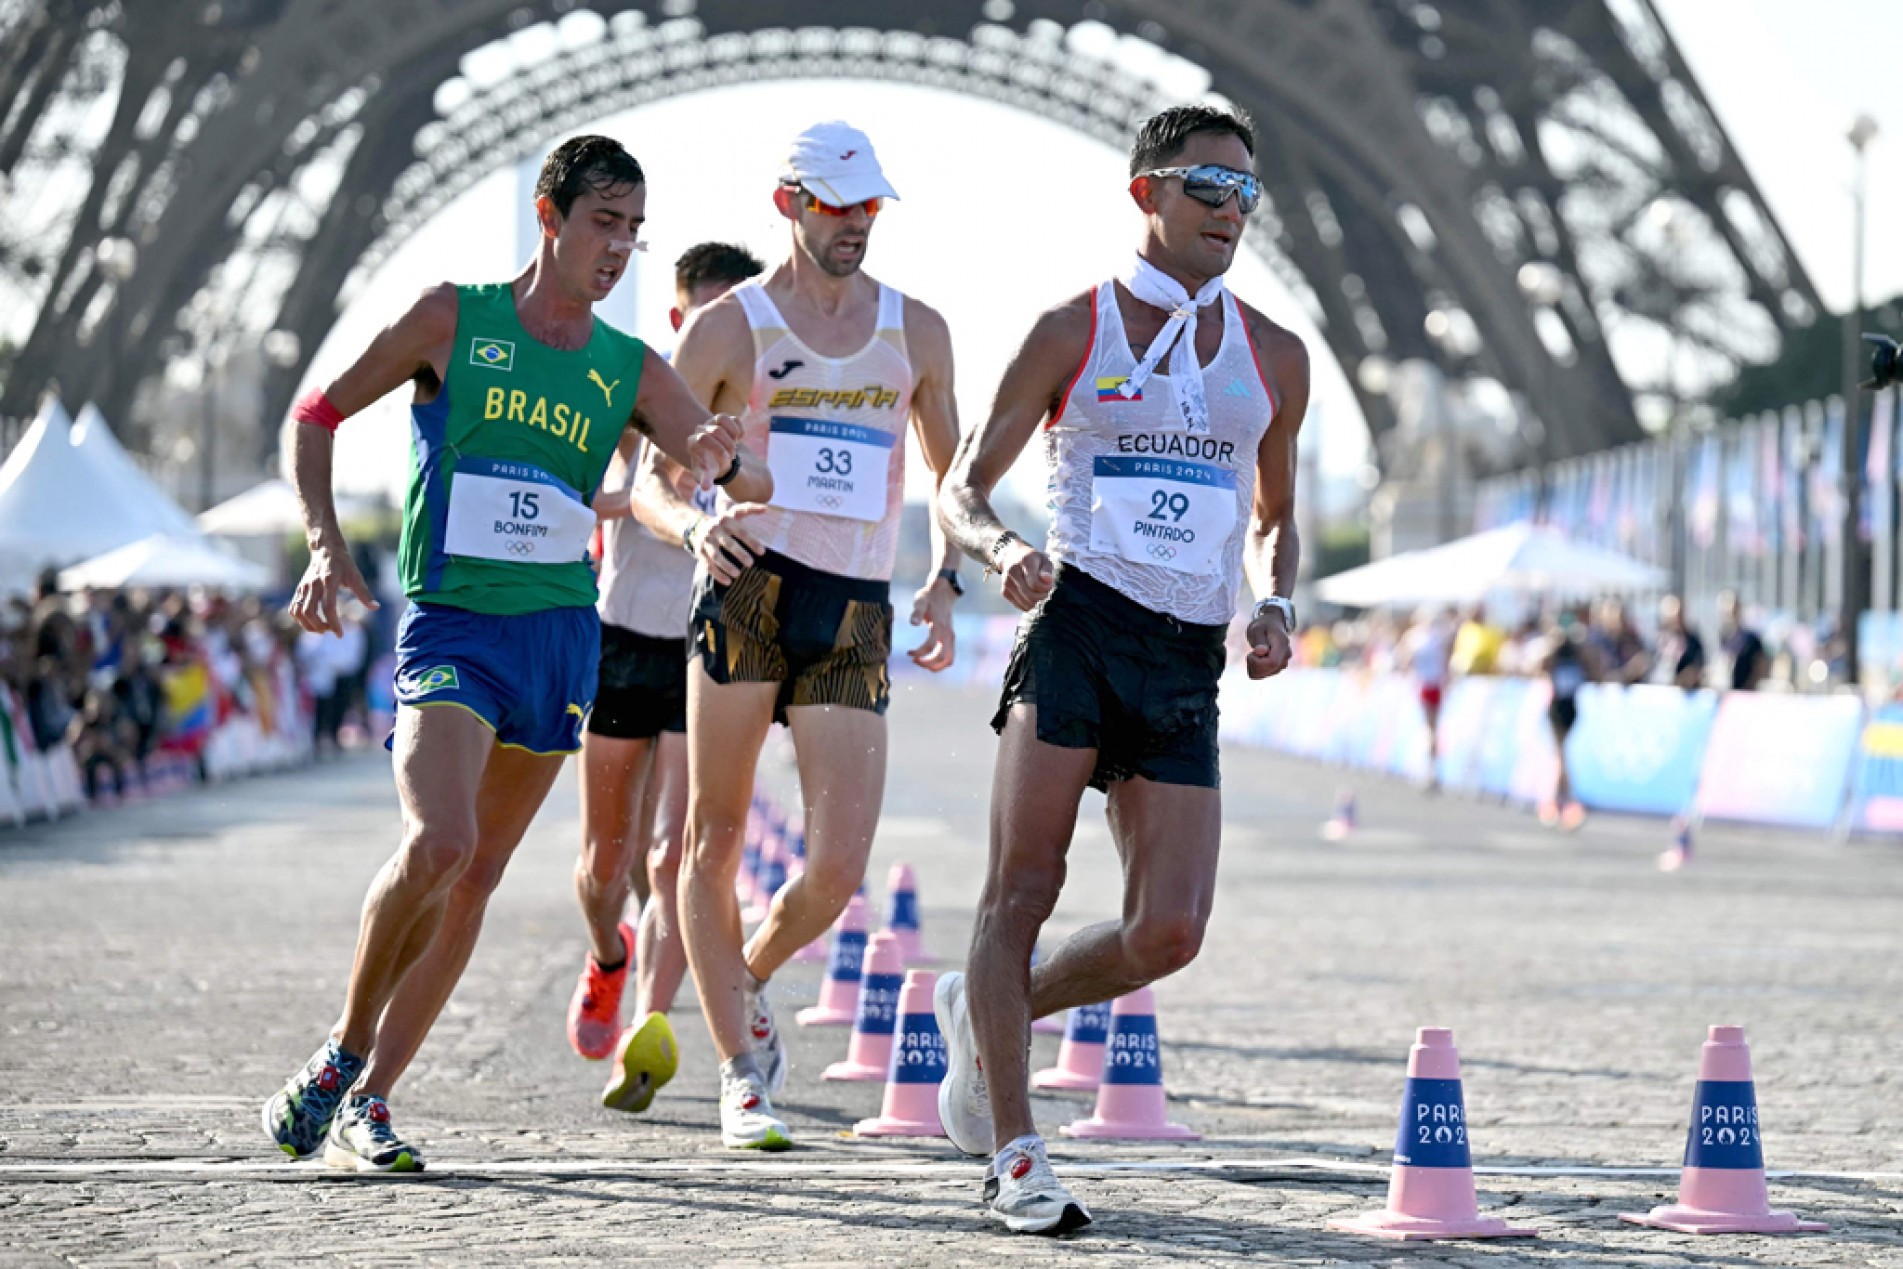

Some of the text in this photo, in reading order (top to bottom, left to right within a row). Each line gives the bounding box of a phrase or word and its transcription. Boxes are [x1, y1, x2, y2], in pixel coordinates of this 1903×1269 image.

[768, 384, 900, 410] ESPAÑA
[484, 386, 591, 452] BRASIL
[803, 422, 839, 436] PARIS
[1118, 432, 1235, 463] ECUADOR
[491, 462, 550, 481] PARIS 20
[815, 447, 852, 476] 33
[1134, 462, 1212, 481] PARIS 2024
[806, 475, 854, 494] MARTIN
[509, 490, 539, 519] 15
[1147, 489, 1190, 523] 29
[1132, 520, 1196, 543] PINTADO
[1106, 1051, 1157, 1068] 2024
[1418, 1125, 1465, 1145] 202
